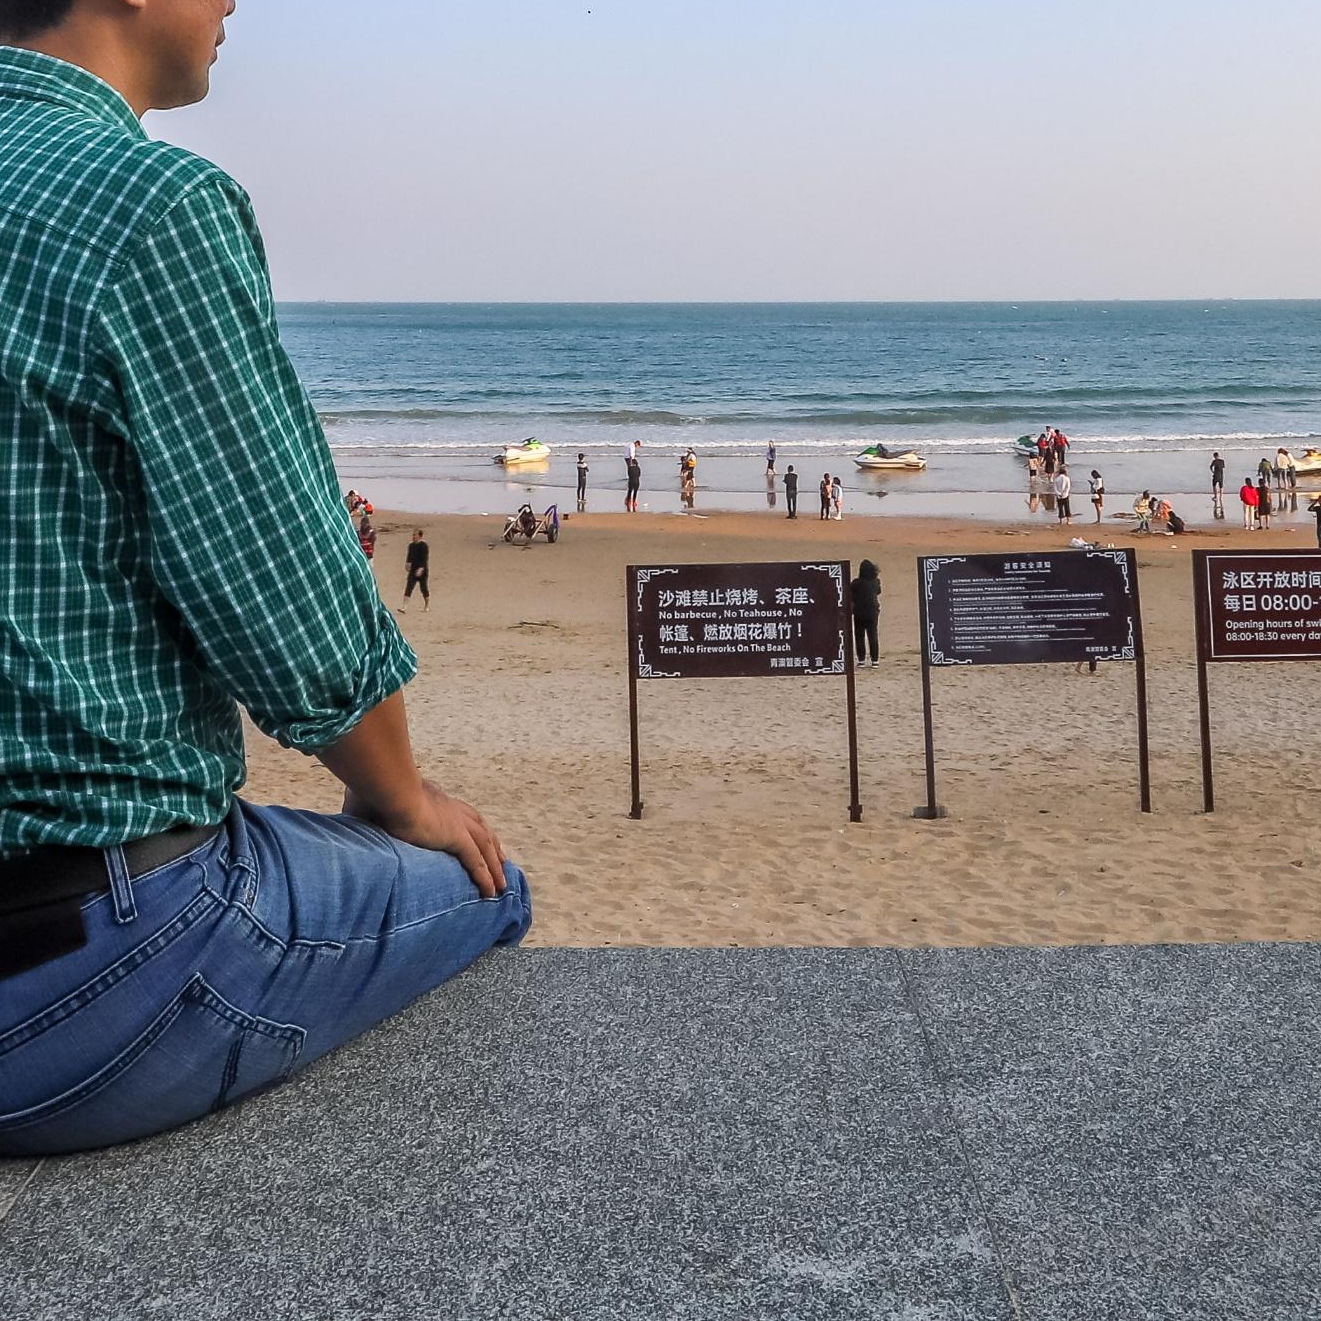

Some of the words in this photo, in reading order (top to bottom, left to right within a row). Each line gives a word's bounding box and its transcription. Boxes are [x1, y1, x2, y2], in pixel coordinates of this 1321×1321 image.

[1224, 595, 1256, 612] 每日
[659, 611, 672, 619] No
[789, 608, 802, 616] No
[1226, 620, 1264, 630] Opening
[1295, 619, 1303, 627] of
[1226, 632, 1278, 641] 08:00-18:30
[697, 644, 735, 653] Fireworks
[737, 644, 749, 652] On
[767, 643, 790, 651] Beach
